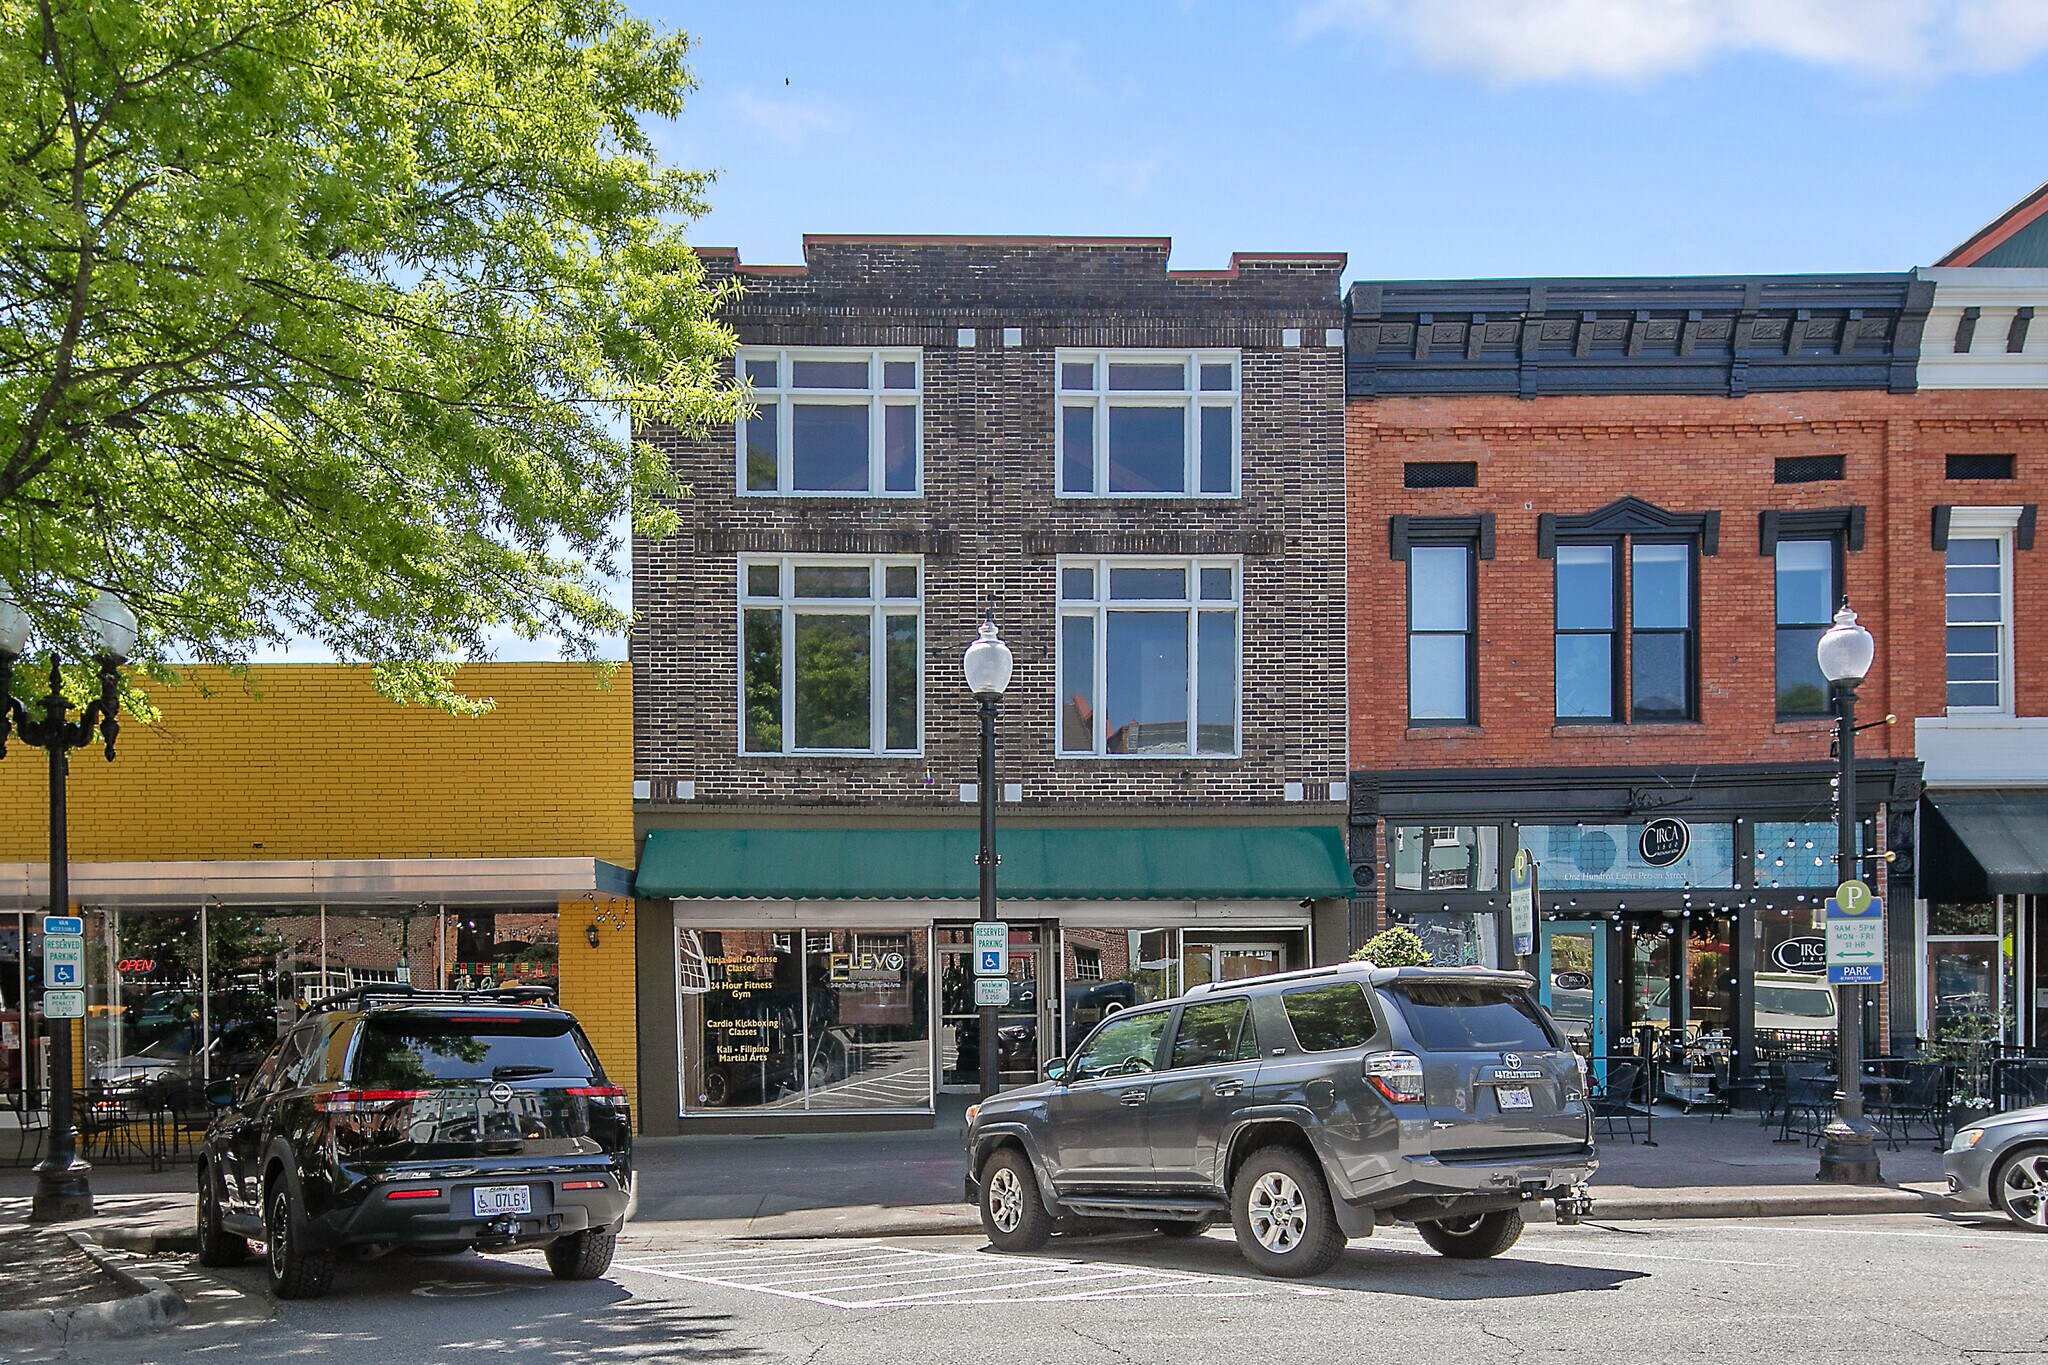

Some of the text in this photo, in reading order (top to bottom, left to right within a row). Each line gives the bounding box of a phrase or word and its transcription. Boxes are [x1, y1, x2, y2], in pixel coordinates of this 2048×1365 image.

[1643, 826, 1678, 857] CIRCA
[1517, 856, 1524, 879] P
[1582, 872, 1613, 880] Hundred
[1616, 872, 1636, 882] Eight
[1665, 871, 1687, 879] Street
[1846, 886, 1863, 909] P
[976, 927, 1005, 937] RESERVED
[47, 940, 80, 949] RESERVED
[978, 939, 1003, 948] PARKING
[49, 952, 78, 961] PARKING
[1778, 942, 1827, 967] CIRC
[117, 959, 153, 972] OPEN
[705, 956, 726, 965] Ninja
[726, 964, 756, 972] Classes
[1843, 966, 1869, 976] PARK
[710, 981, 773, 990] 24 Hour Fitness
[1557, 974, 1586, 988] CIRCA
[732, 990, 751, 1000] Gym
[706, 1019, 779, 1029] Cardio Kickboxing
[728, 1028, 758, 1036] Classes
[716, 1045, 733, 1054] Kali
[740, 1045, 770, 1055] Filipino
[719, 1054, 768, 1062] Martial Arts
[495, 1193, 520, 1208] 07L6
